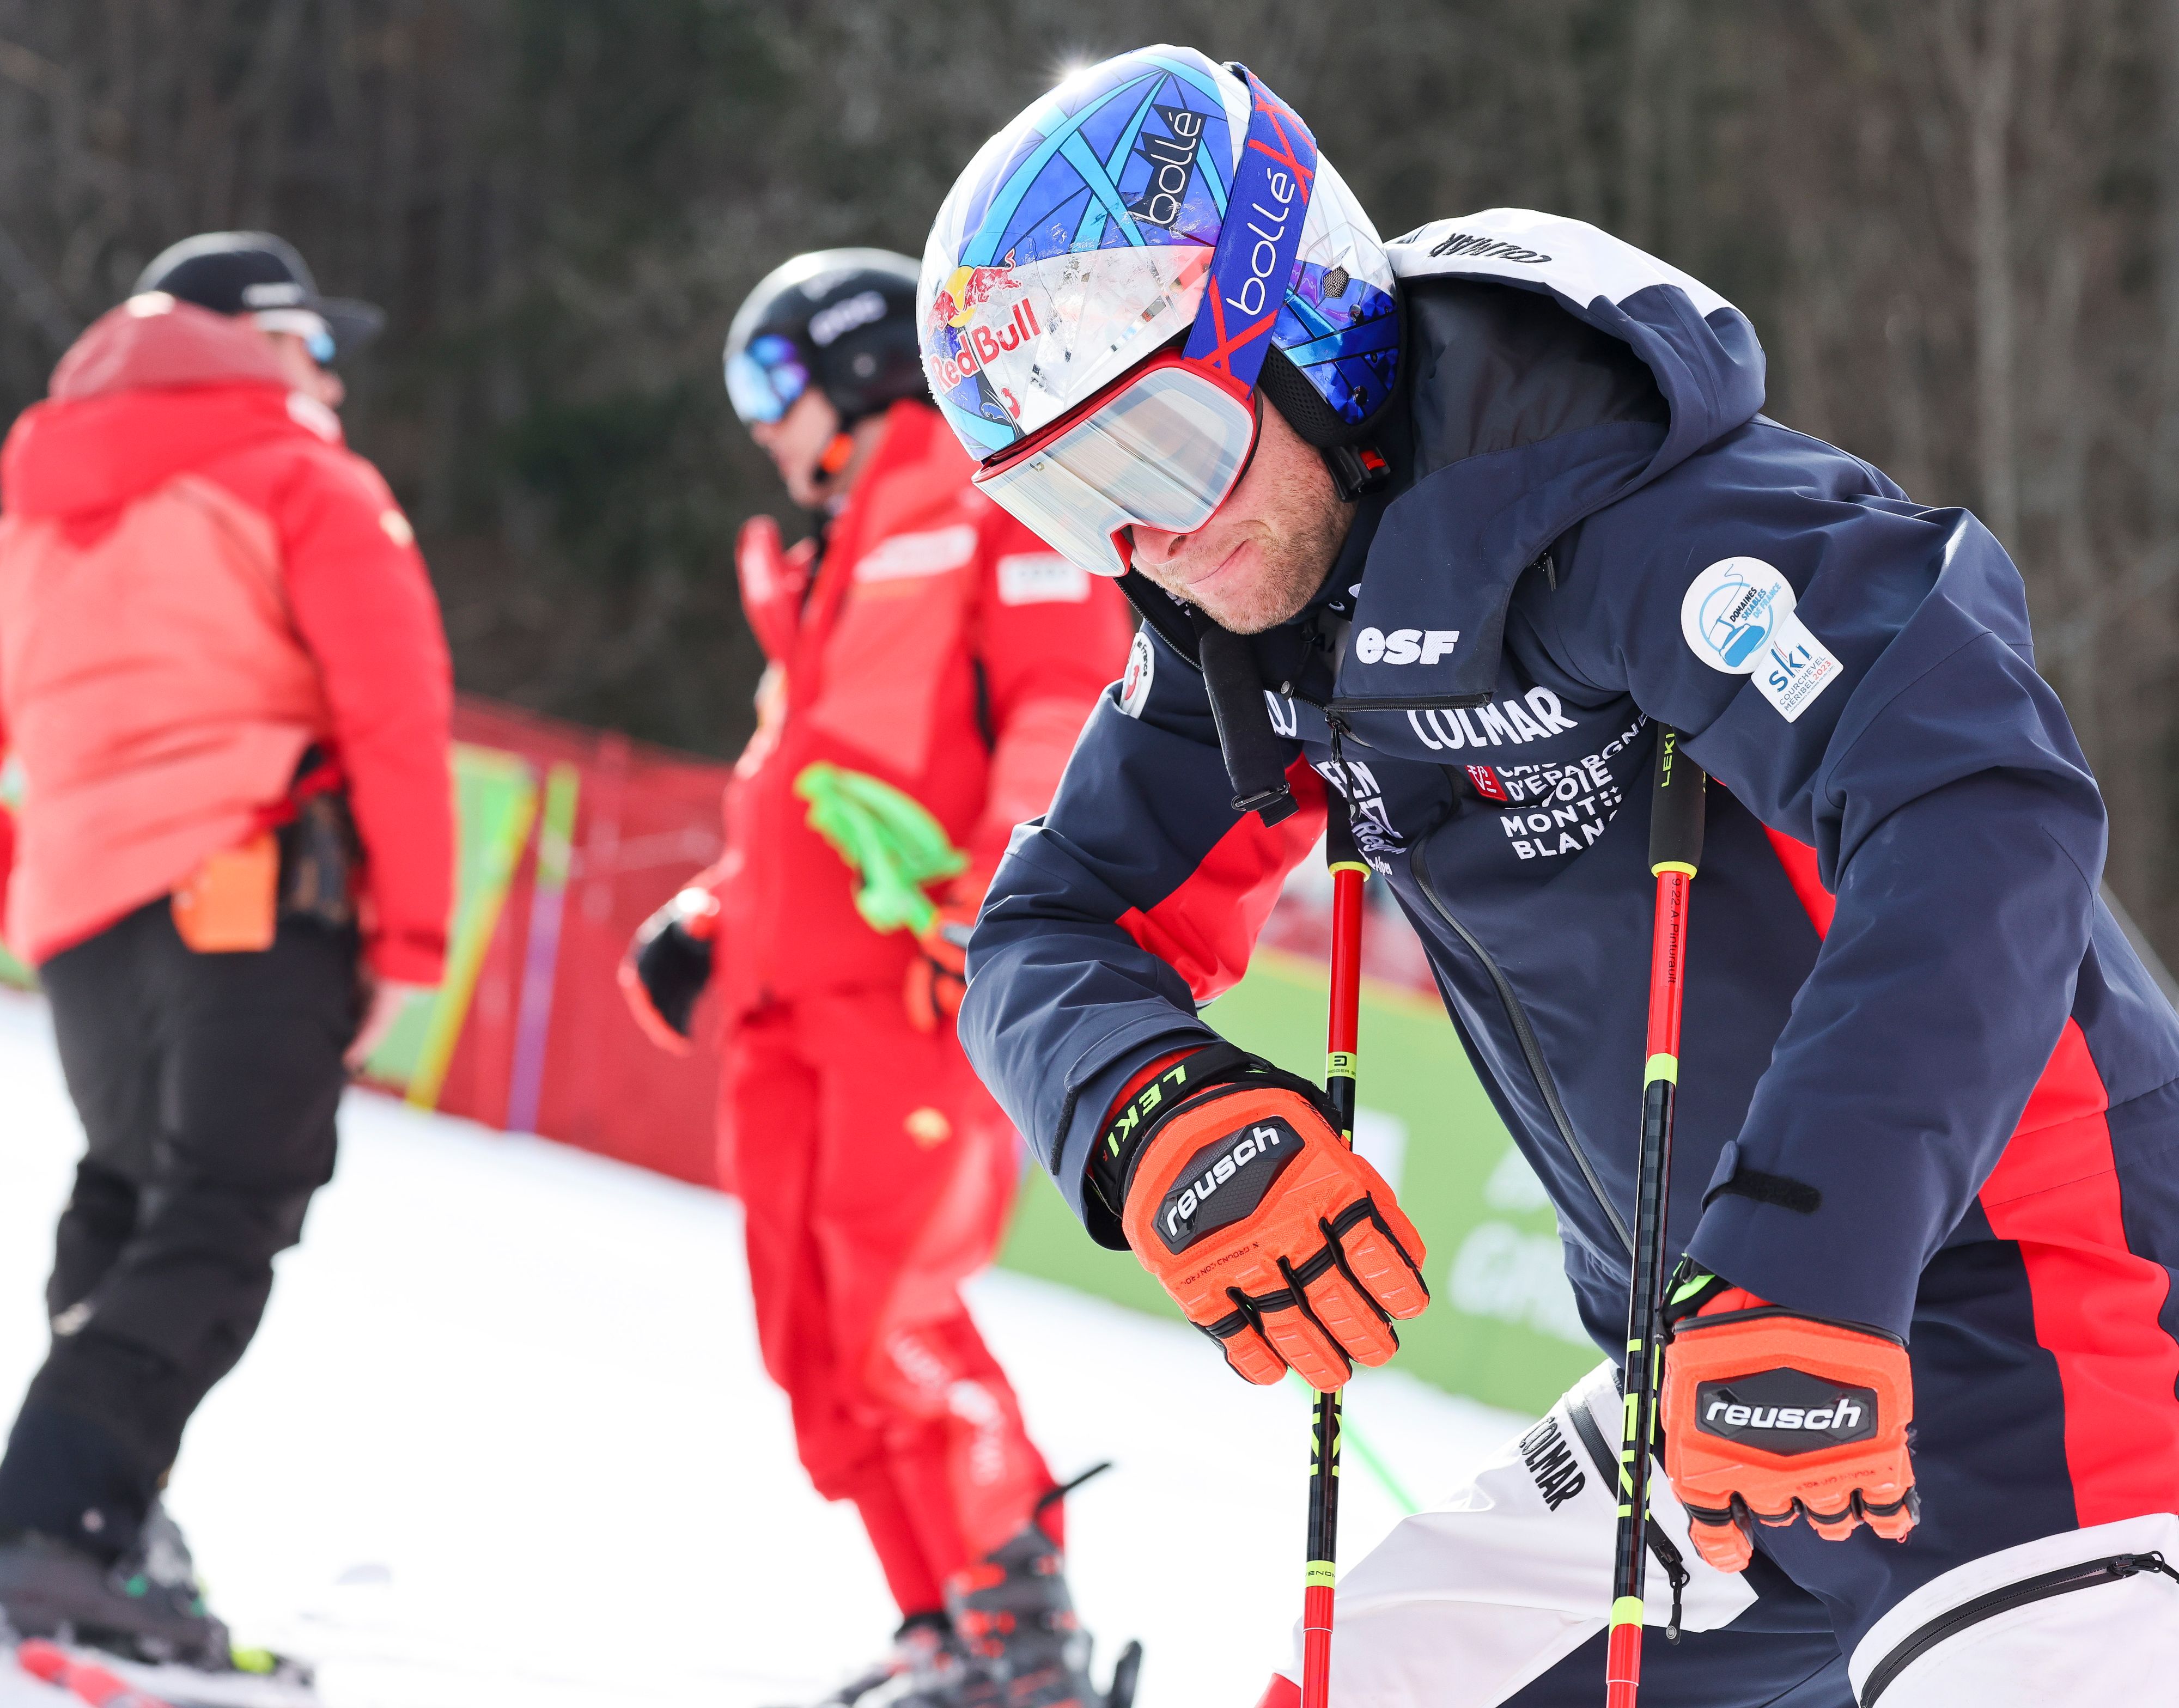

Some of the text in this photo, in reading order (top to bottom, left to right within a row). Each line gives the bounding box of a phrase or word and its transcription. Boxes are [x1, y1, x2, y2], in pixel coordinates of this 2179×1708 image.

[1133, 111, 1202, 225] bollé
[1226, 168, 1295, 314] bollé
[930, 298, 1041, 389] Red Bull
[1730, 587, 1757, 623] DOMAINES
[1741, 588, 1766, 621] SKIABLES
[1753, 582, 1781, 619] DE FRANCE
[1780, 656, 1826, 705] COURCHEVEL
[1813, 661, 1831, 680] 2023
[1407, 686, 1579, 750] COLMAR
[1661, 733, 1675, 788] LEKI
[1500, 796, 1596, 838] MONT
[1511, 809, 1618, 860] BLAN
[1107, 1065, 1186, 1158] LEKI
[1165, 1126, 1280, 1236] reusch
[1217, 1246, 1250, 1265] GROUND
[1705, 1398, 1861, 1431] reusch
[1519, 1416, 1586, 1512] COLMAR
